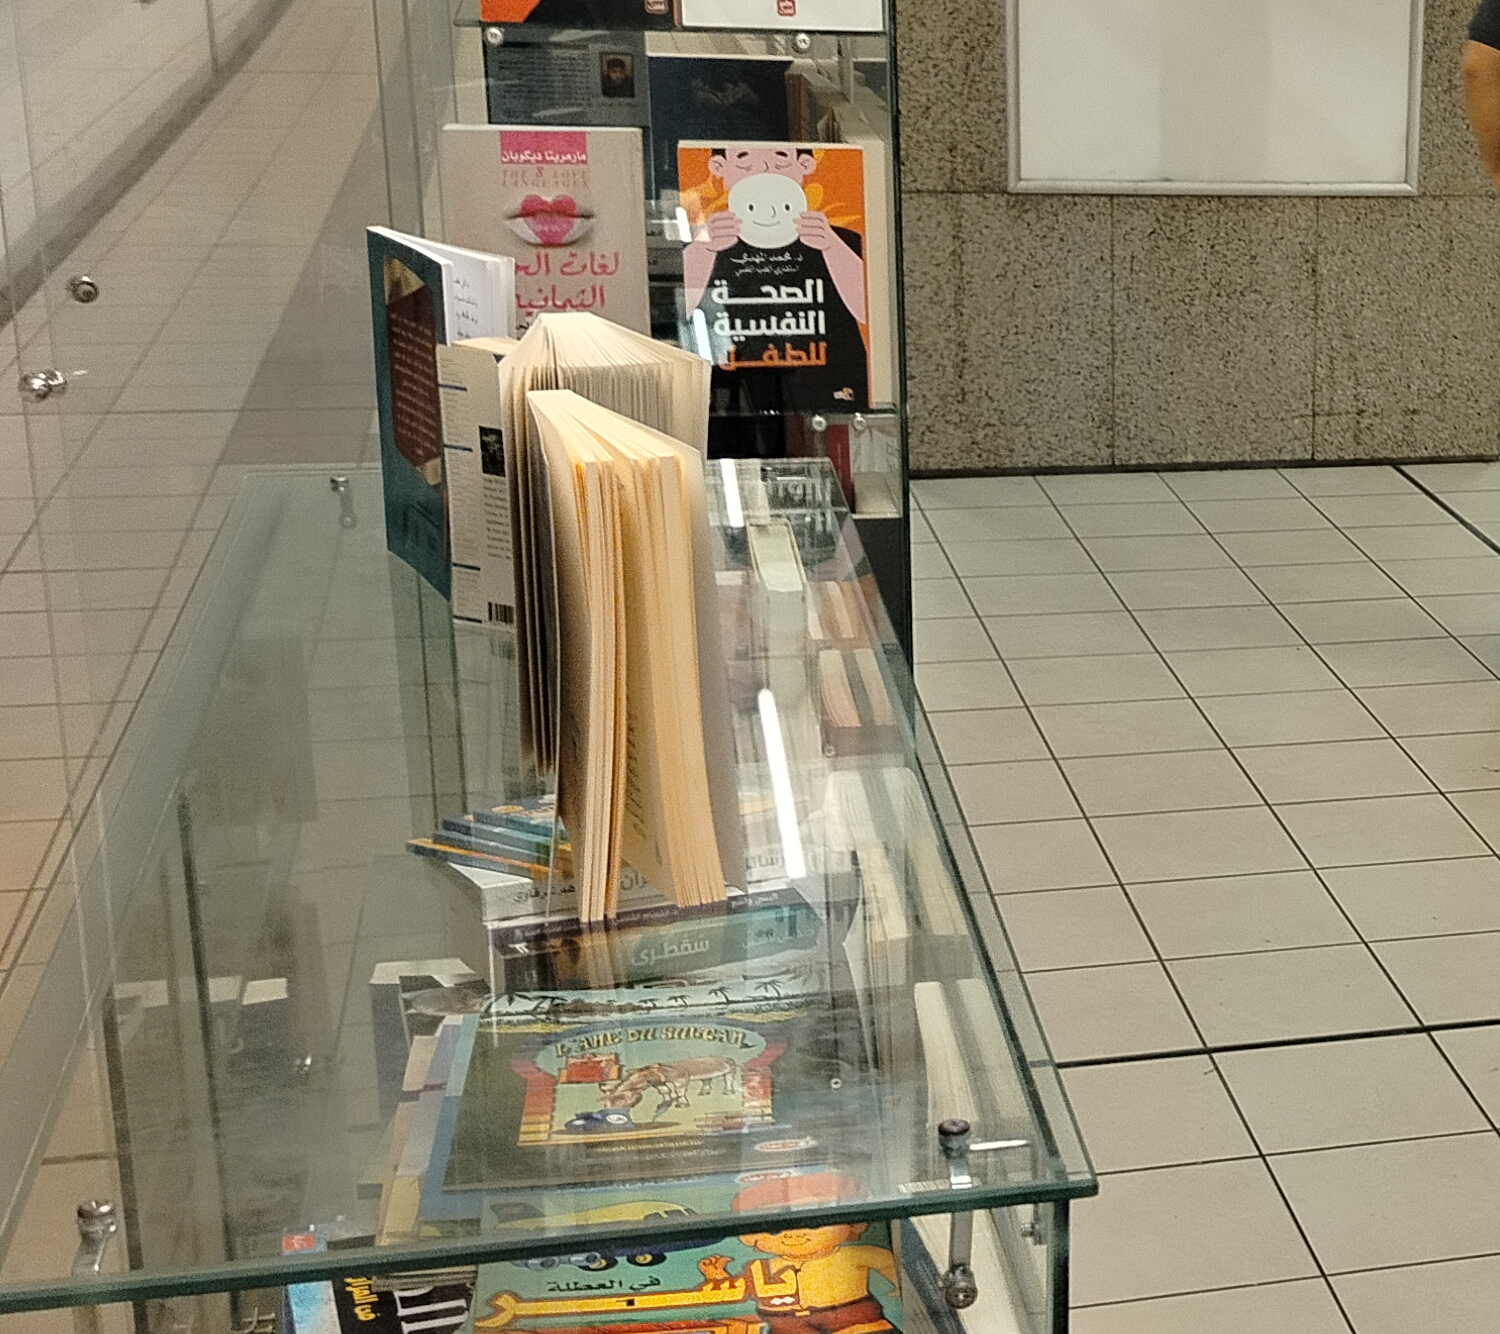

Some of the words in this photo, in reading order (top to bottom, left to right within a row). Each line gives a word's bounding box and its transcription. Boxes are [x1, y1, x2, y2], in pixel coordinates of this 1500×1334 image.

[559, 251, 620, 276] لغات
[713, 310, 826, 342] النفسية
[547, 1278, 623, 1294] العطلة
[630, 1275, 662, 1292] في
